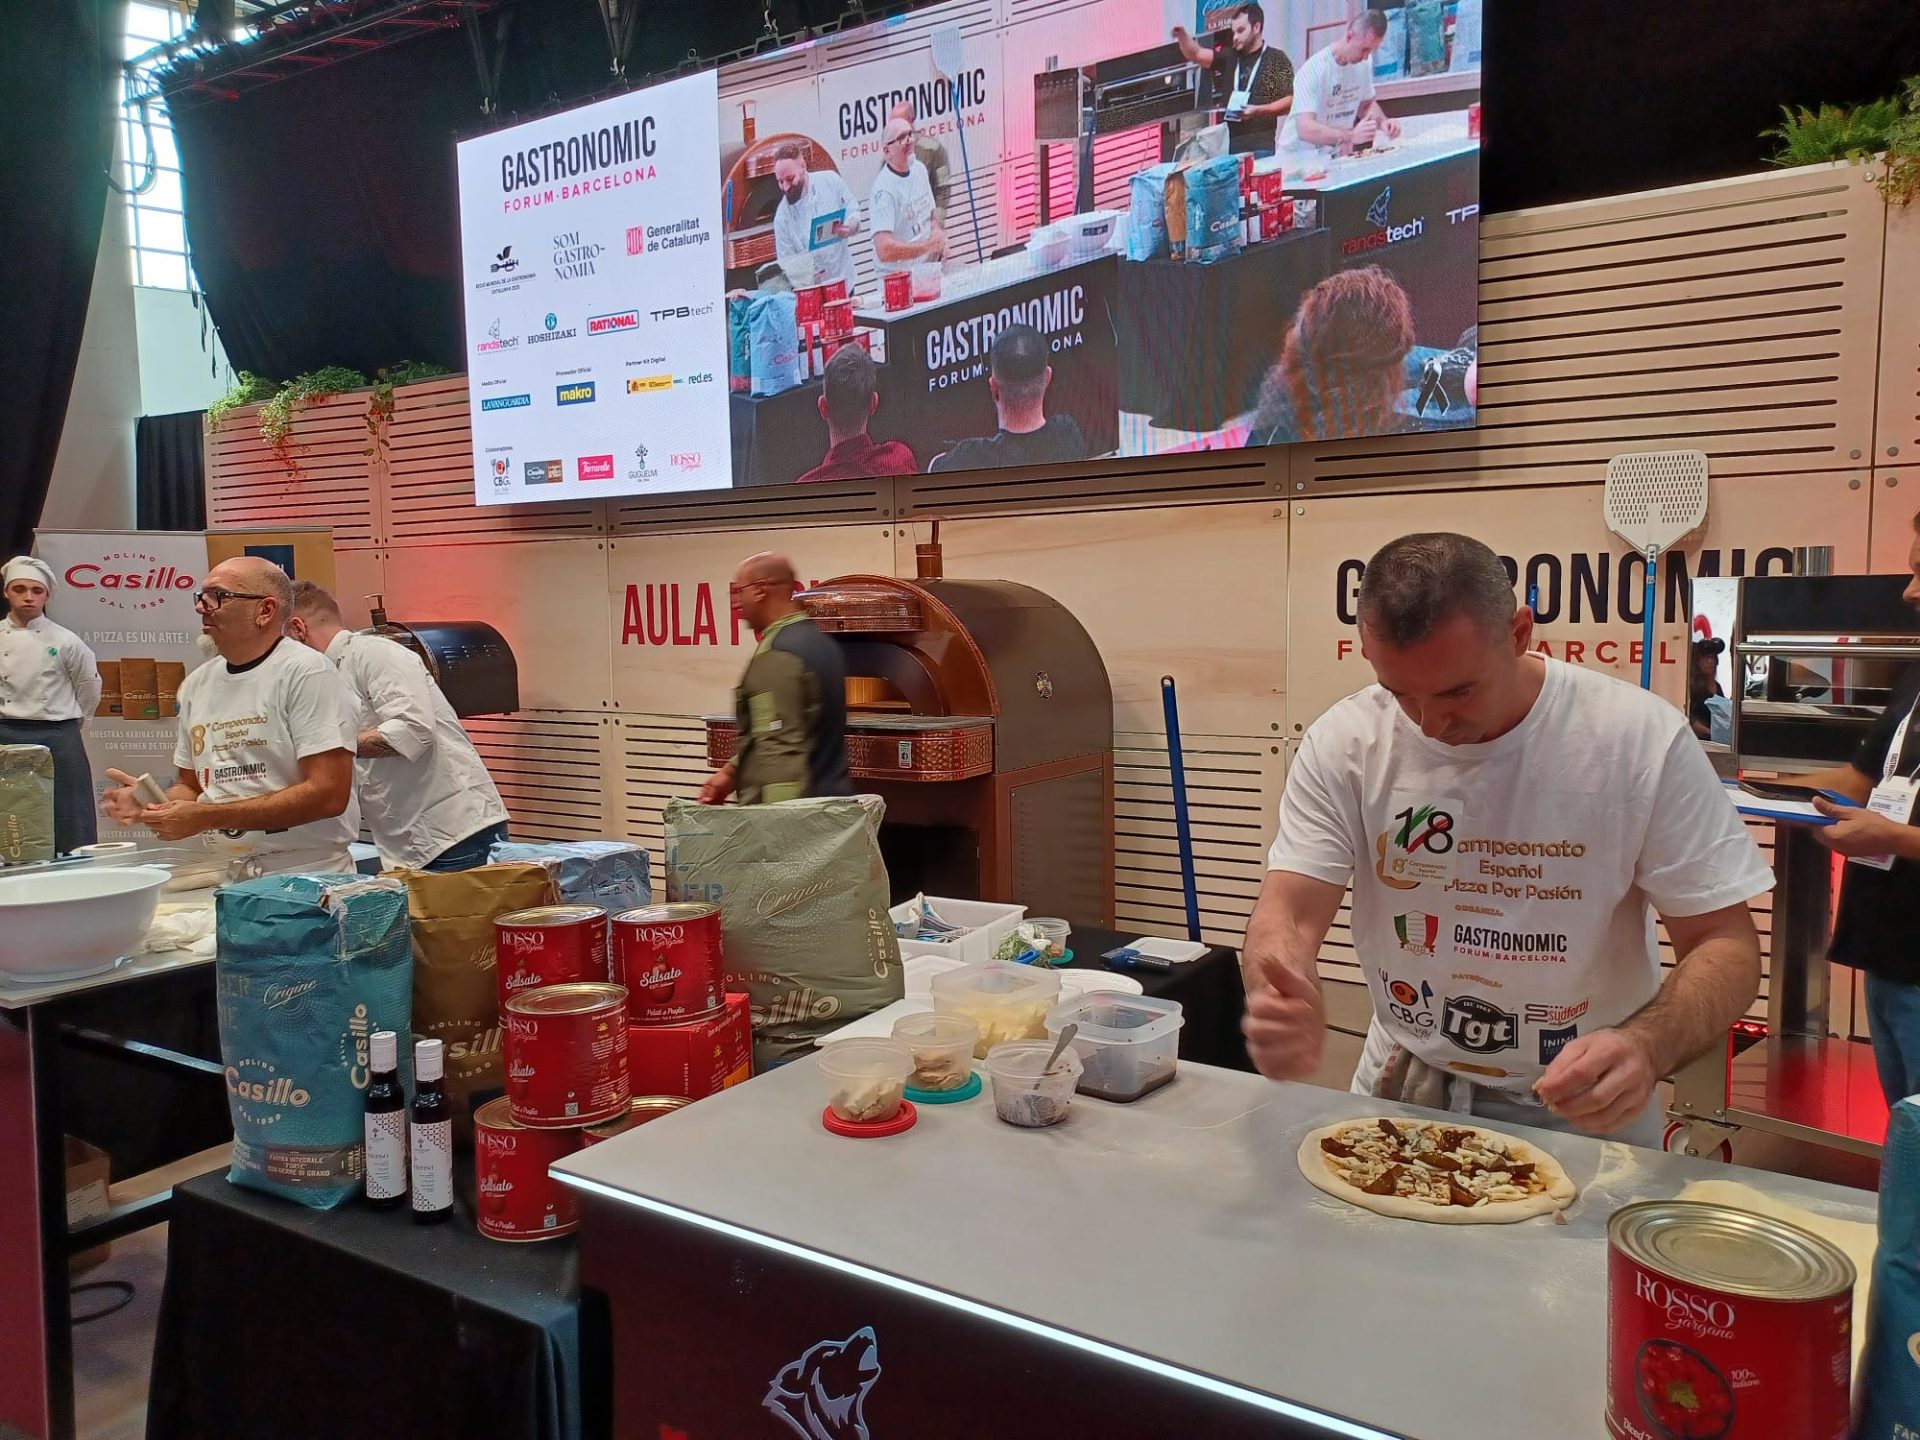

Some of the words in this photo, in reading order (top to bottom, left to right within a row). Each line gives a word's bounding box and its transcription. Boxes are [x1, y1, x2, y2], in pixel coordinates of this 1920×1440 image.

[502, 116, 657, 192] GASTRONOMIC
[646, 217, 700, 238] Generalitat
[553, 231, 580, 249] SOM
[647, 240, 660, 253] de
[661, 230, 710, 251] Catalunya
[553, 246, 606, 267] GASTRO-
[555, 260, 596, 282] NOMIA
[590, 314, 637, 332] RATIONAL
[477, 336, 518, 352] randstech
[527, 328, 577, 345] HOSHIZAKI
[688, 371, 713, 385] red.es
[560, 386, 593, 402] makro
[103, 552, 156, 563] MOLINO
[64, 563, 196, 592] Casillo
[99, 597, 125, 610] DAL
[621, 582, 718, 646] AULA
[93, 631, 123, 644] PIZZA
[126, 631, 138, 644] ES
[140, 631, 156, 644] UN
[123, 692, 157, 700] Casillo
[225, 728, 249, 739] Español
[105, 741, 119, 751] CON
[120, 741, 147, 751] GERMEN
[148, 741, 158, 751] DE
[8, 814, 21, 858] Casillo
[1456, 838, 1587, 859] ampeonato
[1479, 858, 1543, 879] Español
[756, 876, 836, 916] Origine
[1492, 880, 1522, 898] Por
[1525, 884, 1583, 900] Pasión
[502, 931, 545, 945] ROSSO
[635, 925, 684, 942] ROSSO
[868, 907, 889, 979] Casillo
[1454, 923, 1568, 953] GASTRONOMIC
[505, 973, 542, 989] Salsato
[640, 967, 682, 987] Salsato
[726, 973, 781, 985] OLINO
[263, 977, 318, 1008] Origine
[1447, 1007, 1513, 1047] Tgt
[349, 1003, 370, 1090] Casillo
[239, 1058, 276, 1073] MOLINO
[224, 1065, 311, 1108] Casillo
[478, 1130, 517, 1151] ROSSO
[306, 1169, 330, 1178] GRANO
[480, 1177, 514, 1193] Salsato
[1635, 1270, 1735, 1328] ROSSO
[1665, 1304, 1734, 1338] Gargano
[1623, 1418, 1645, 1440] Diced
